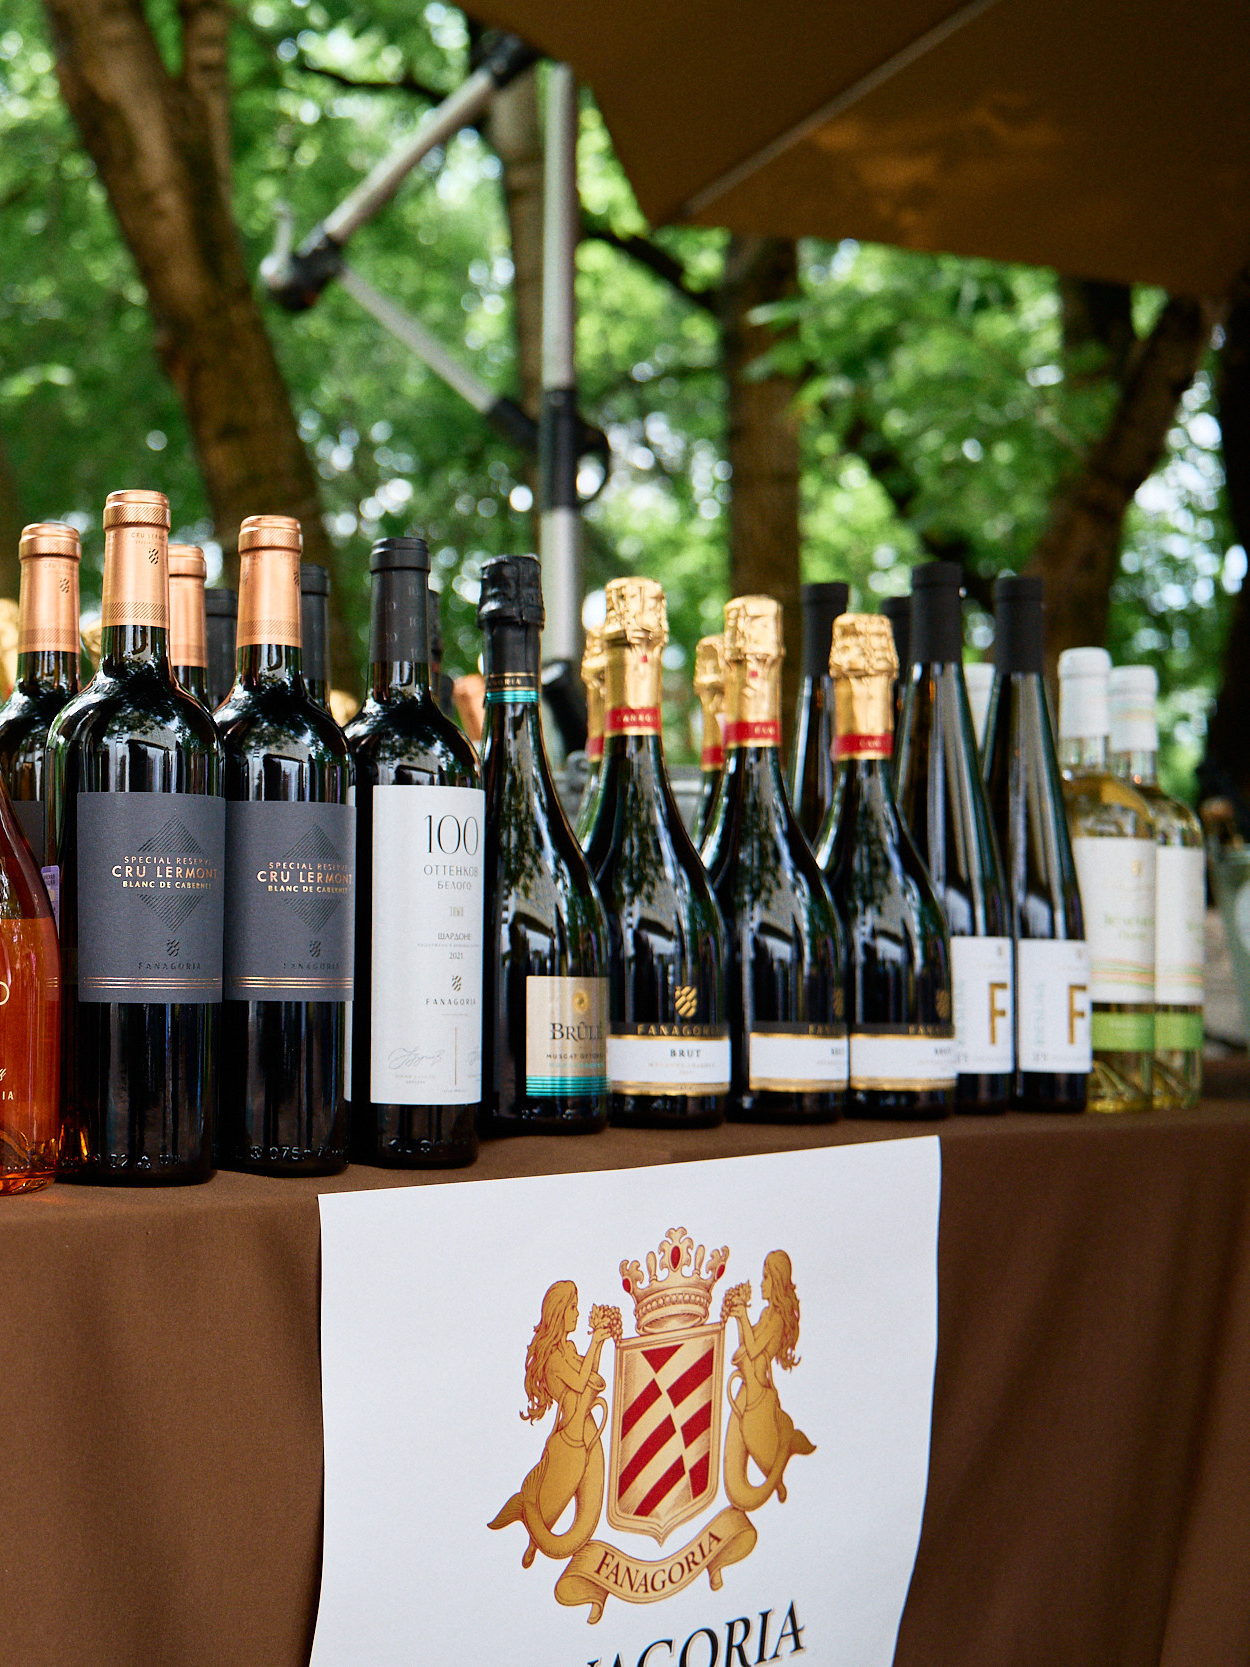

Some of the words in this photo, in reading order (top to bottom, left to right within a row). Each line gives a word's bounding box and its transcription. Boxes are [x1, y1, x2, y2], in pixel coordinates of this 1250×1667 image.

[424, 814, 479, 856] 100
[124, 856, 171, 864] SPECIAL
[269, 862, 313, 870] SPECIAL
[423, 864, 478, 877] ОТТЕНКОВ
[111, 865, 146, 878] CRU
[156, 866, 218, 879] LERMONT
[257, 870, 290, 883] CRU
[299, 871, 352, 885] LERMONT
[122, 880, 156, 888] BLANC
[159, 881, 171, 889] DE
[437, 880, 472, 890] БЕЛОГО
[138, 962, 201, 970] FANAGORIA
[425, 998, 477, 1006] FANAGORIA
[989, 982, 1008, 1045] F
[1069, 984, 1088, 1045] F
[669, 1049, 701, 1057] BRUT
[594, 1531, 723, 1594] FANAGORIA
